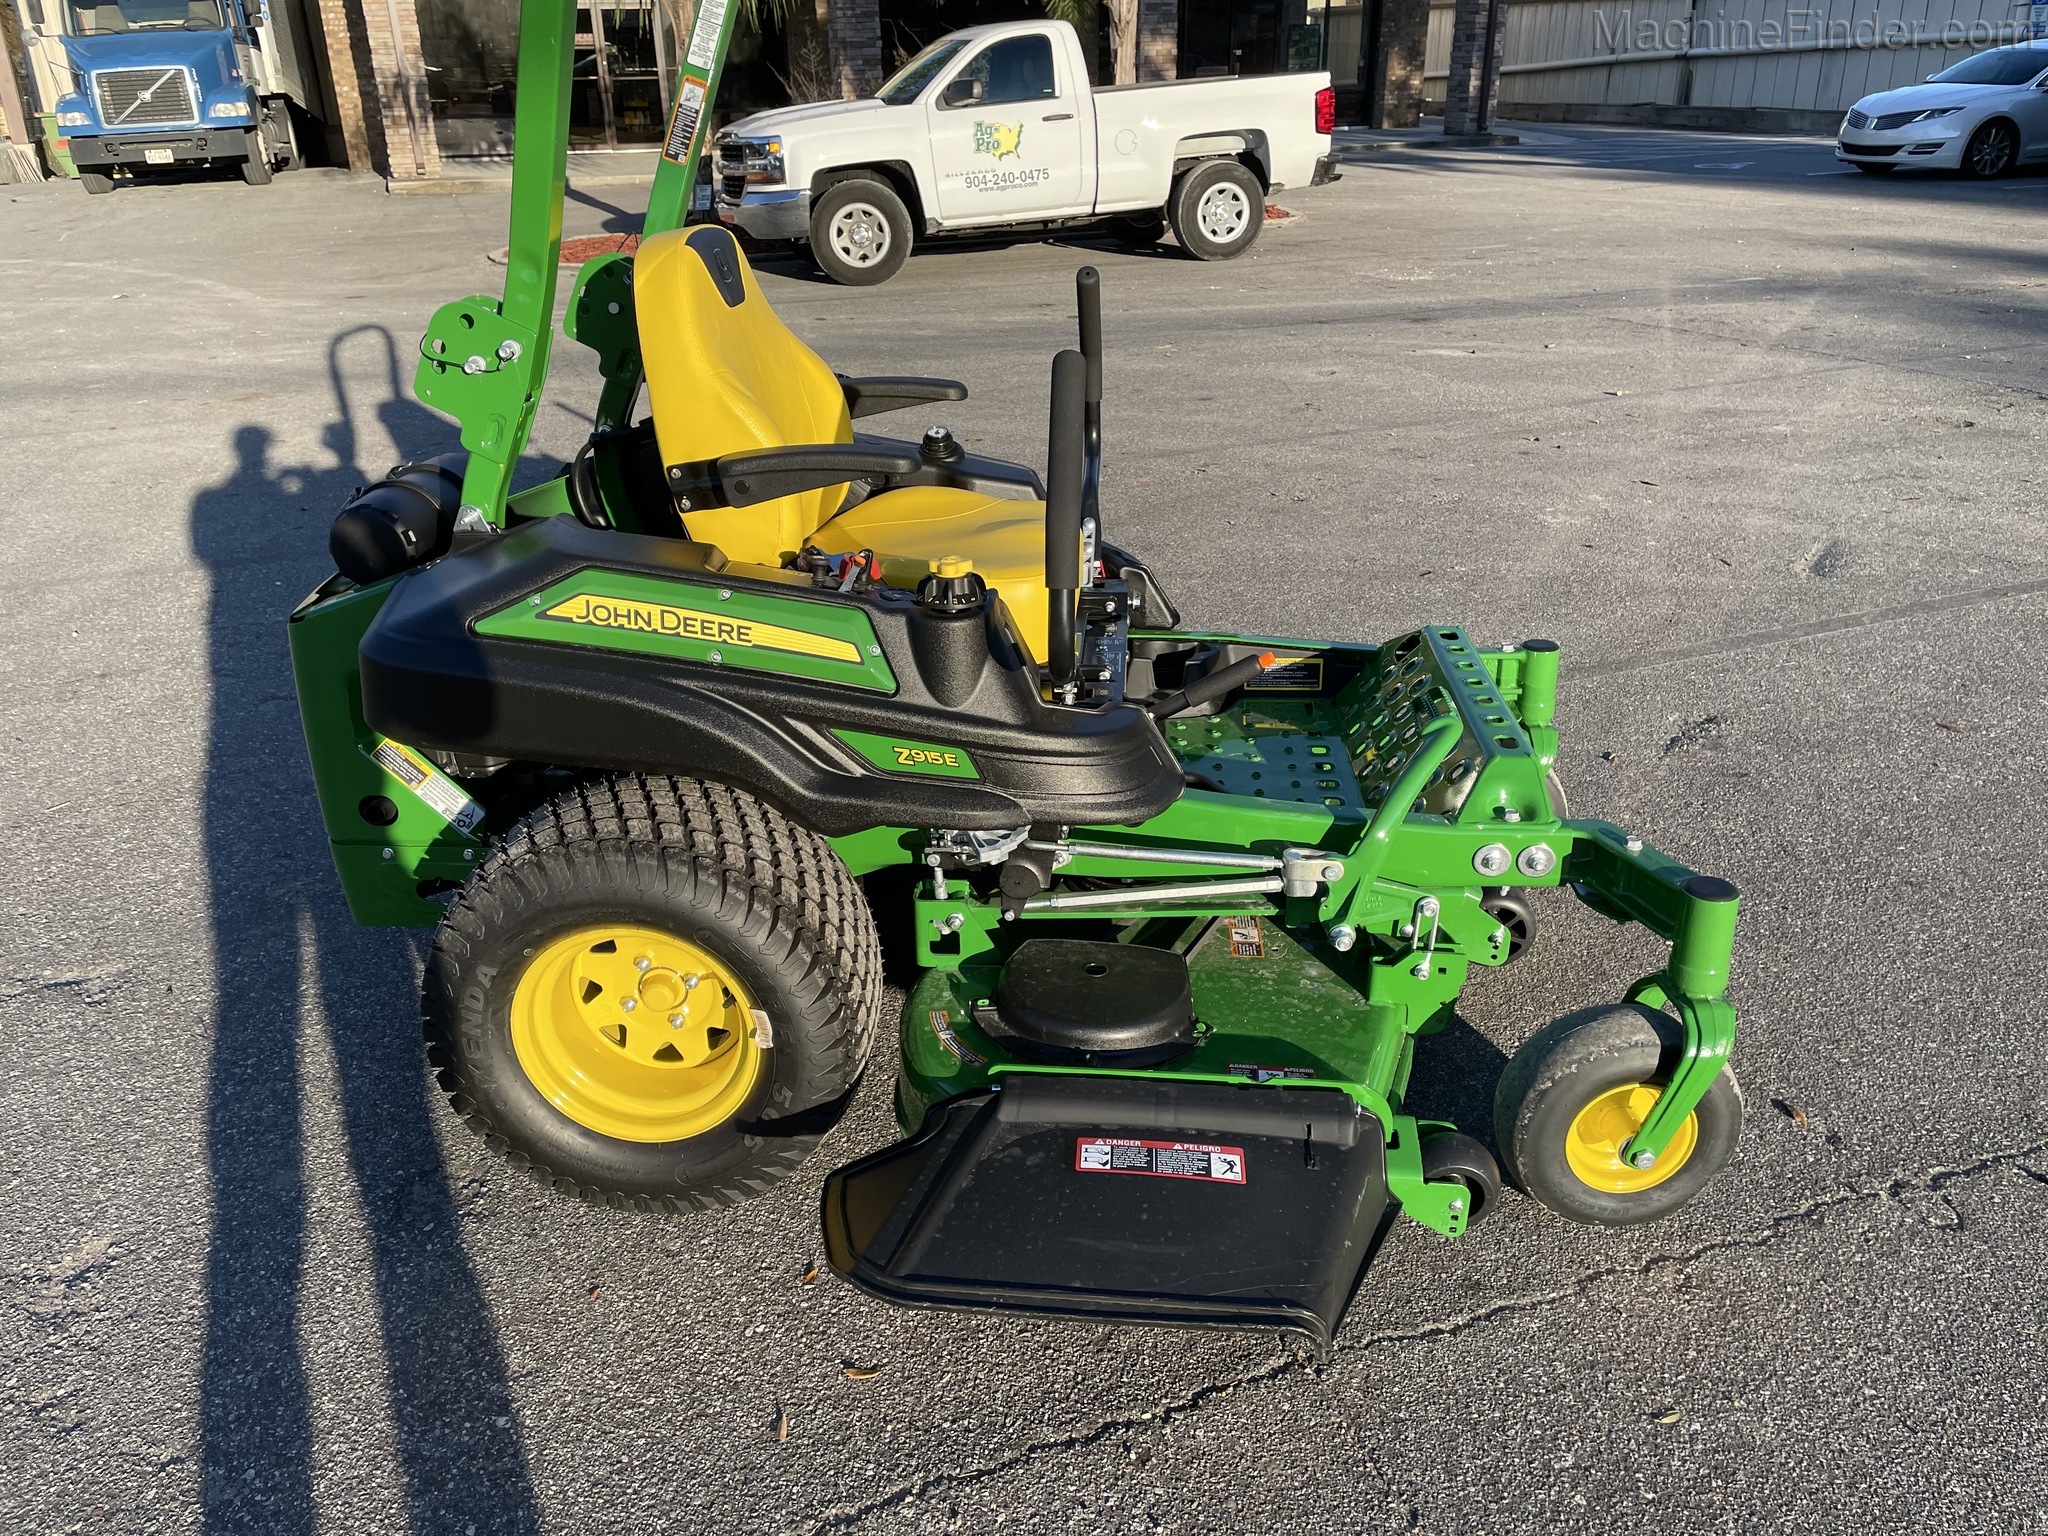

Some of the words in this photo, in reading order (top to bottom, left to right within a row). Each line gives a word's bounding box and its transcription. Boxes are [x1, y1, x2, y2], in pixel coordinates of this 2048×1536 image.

[974, 138, 1001, 152] Pro
[965, 168, 1050, 188] 904-240-0475
[978, 180, 1039, 193] www.agproco.com
[575, 599, 652, 628] JOHN
[659, 608, 752, 643] DEERE
[399, 748, 422, 768] CAUTION
[892, 746, 960, 767] Z915E
[461, 963, 500, 1089] KENDA
[1105, 1138, 1142, 1147] DANGER
[1183, 1143, 1222, 1153] PELIGRO
